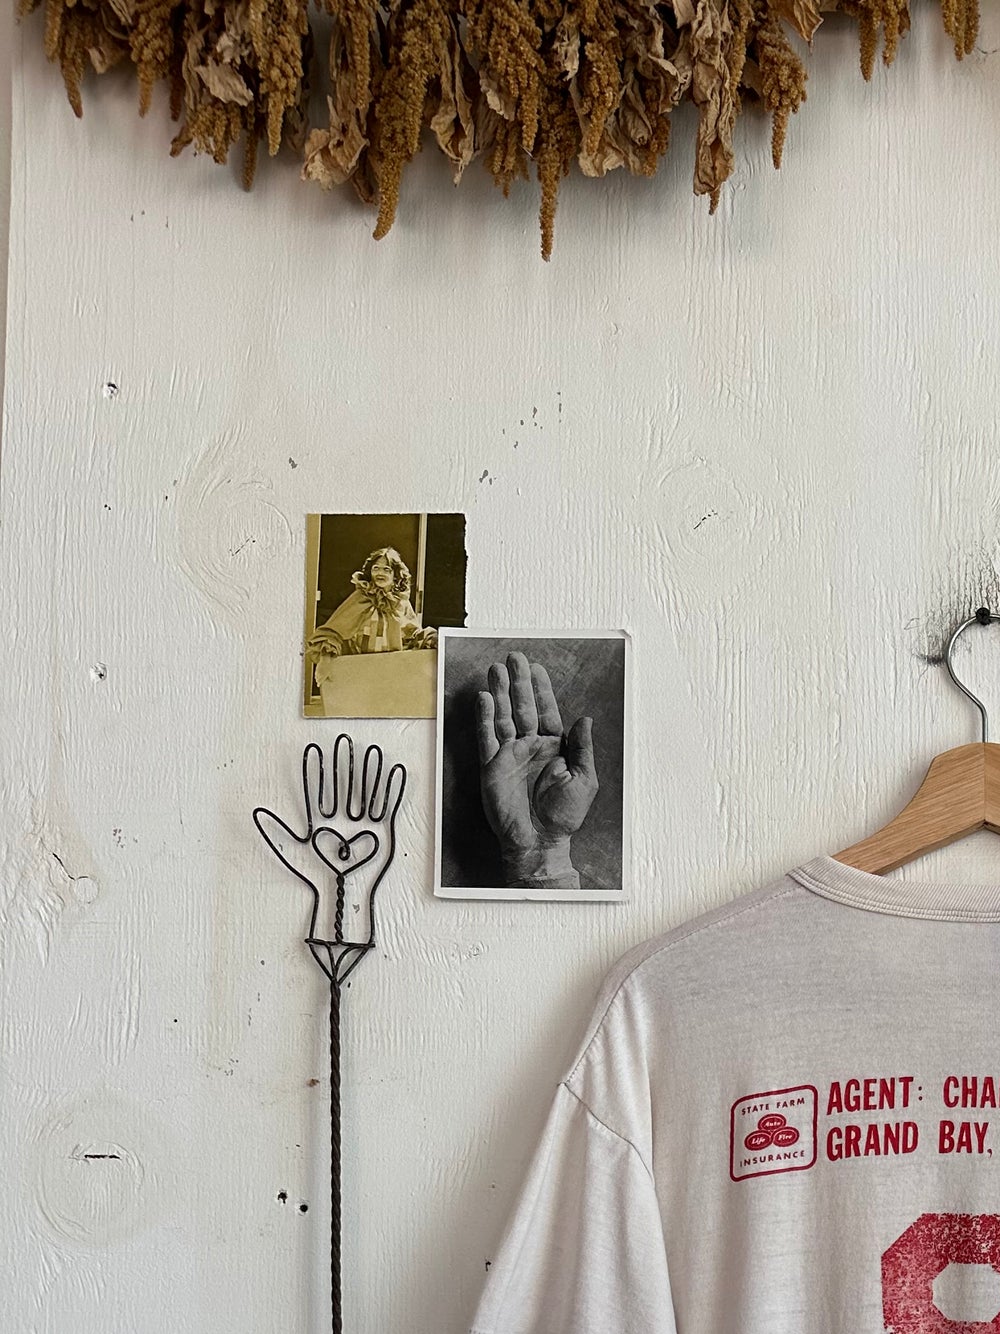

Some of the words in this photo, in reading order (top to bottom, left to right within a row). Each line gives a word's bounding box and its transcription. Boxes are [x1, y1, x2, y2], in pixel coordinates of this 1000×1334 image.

[741, 1103, 770, 1116] STATE
[776, 1097, 805, 1109] FARM
[826, 1076, 924, 1116] AGENT:
[826, 1121, 919, 1161] GRAND
[937, 1121, 994, 1160] BAY,
[739, 1150, 806, 1168] INSURANCE
